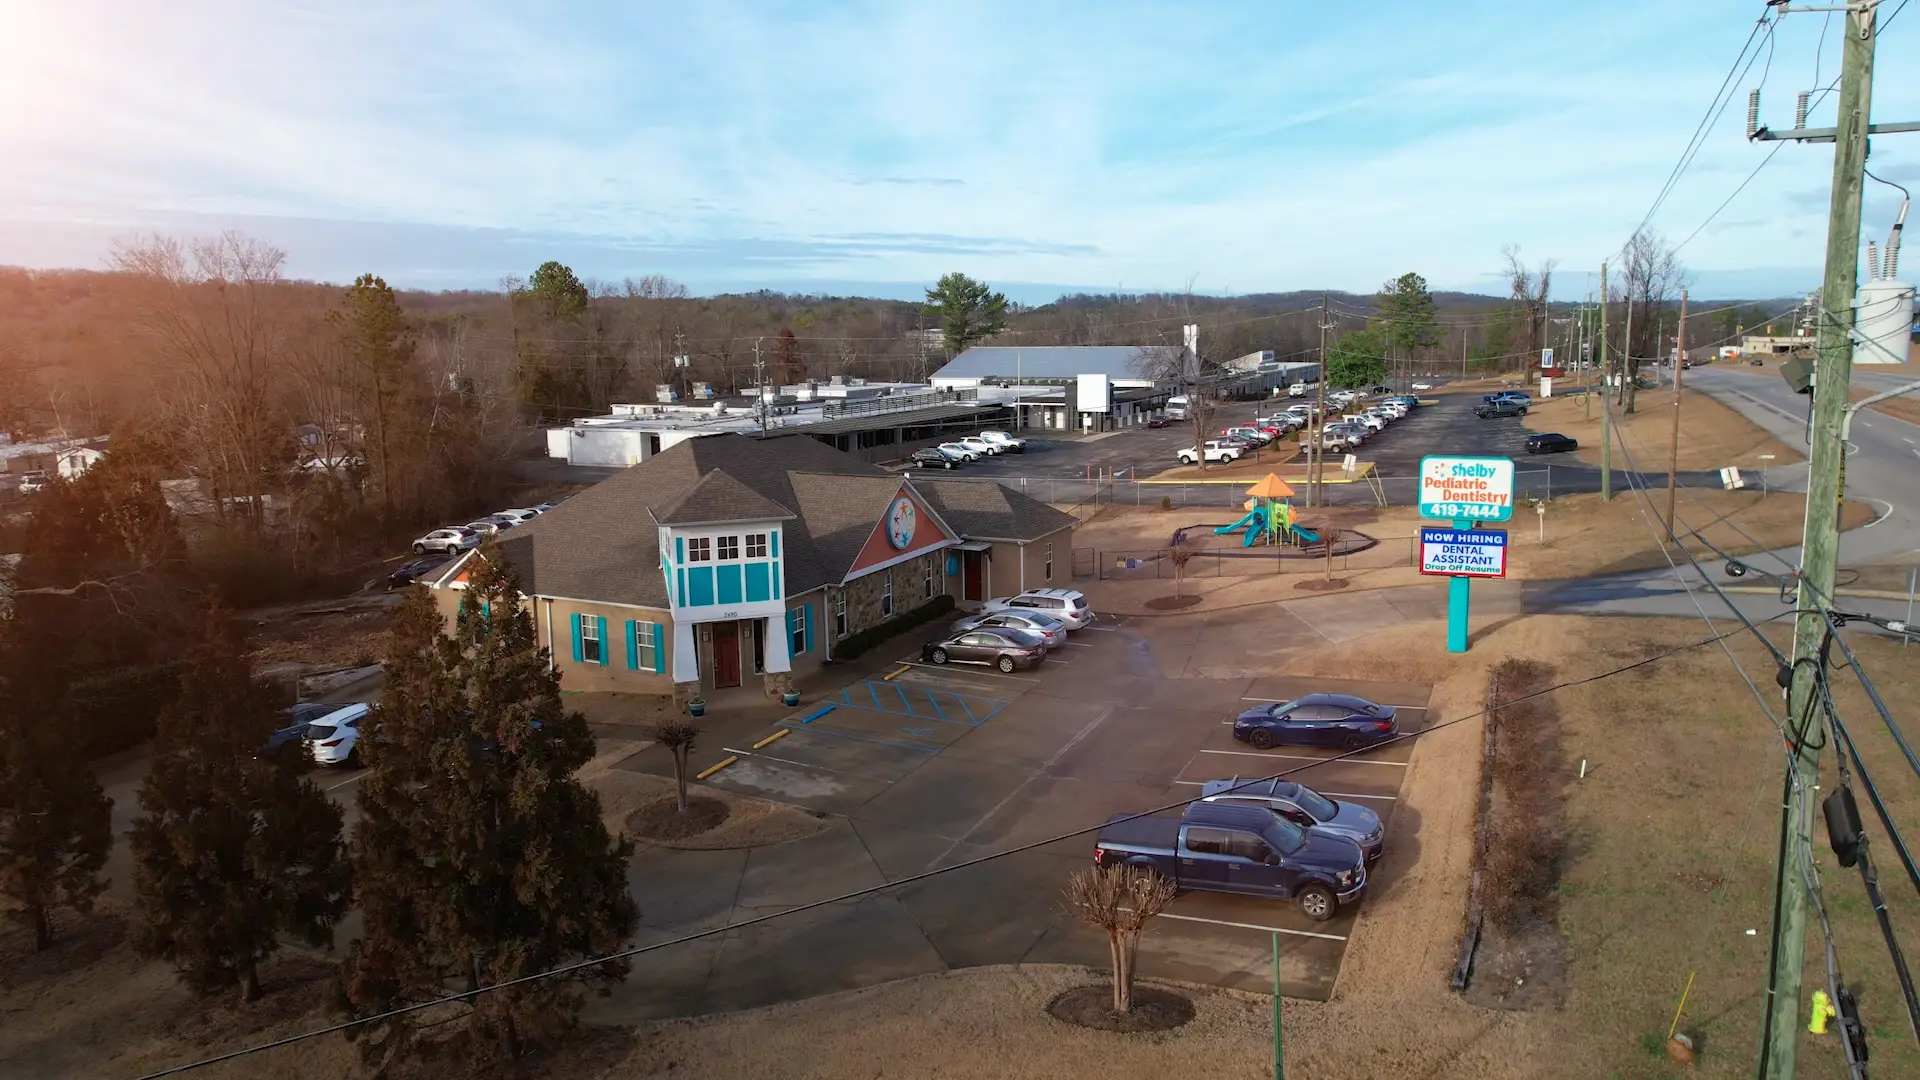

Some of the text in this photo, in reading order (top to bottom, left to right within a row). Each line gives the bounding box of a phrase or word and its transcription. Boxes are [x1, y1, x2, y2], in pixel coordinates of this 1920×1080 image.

[1452, 463, 1496, 478] shelby
[1424, 477, 1488, 490] Pediatric
[1443, 489, 1508, 506] Dentistry
[1430, 504, 1500, 518] 419-7444
[1424, 533, 1503, 544] NOW HIRING
[1442, 545, 1484, 555] DENTAL
[1432, 554, 1494, 565] ASSISTANT
[1425, 563, 1446, 571] Drop
[1465, 565, 1500, 573] Resume
